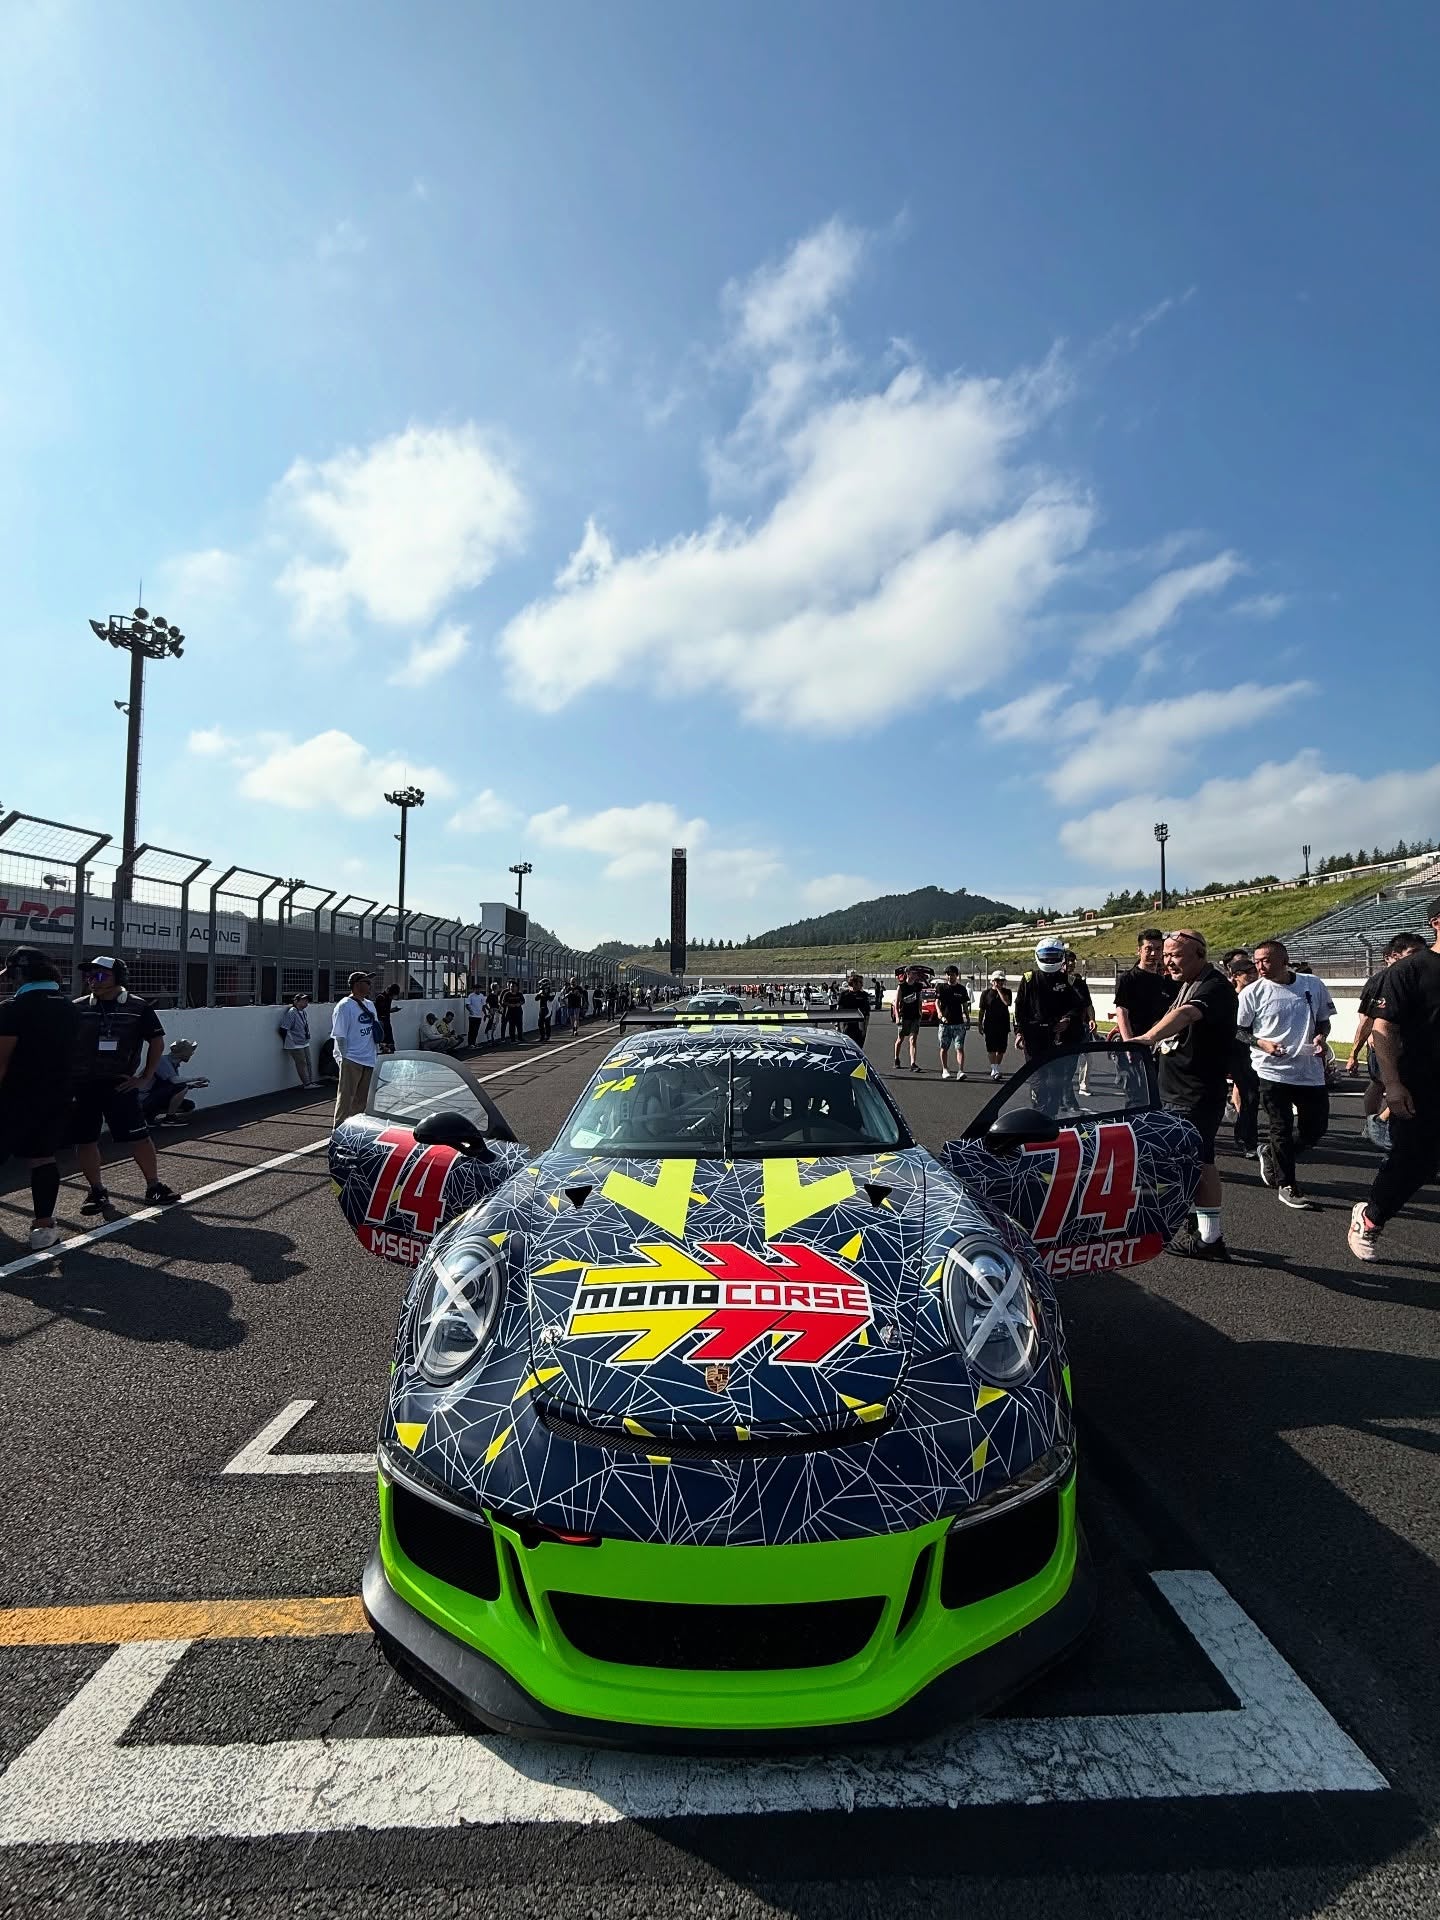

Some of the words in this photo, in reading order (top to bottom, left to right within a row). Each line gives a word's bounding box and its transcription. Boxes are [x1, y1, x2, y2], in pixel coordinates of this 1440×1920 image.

[592, 1075, 637, 1100] 74
[364, 1126, 461, 1236] 74
[1021, 1122, 1141, 1243] 74
